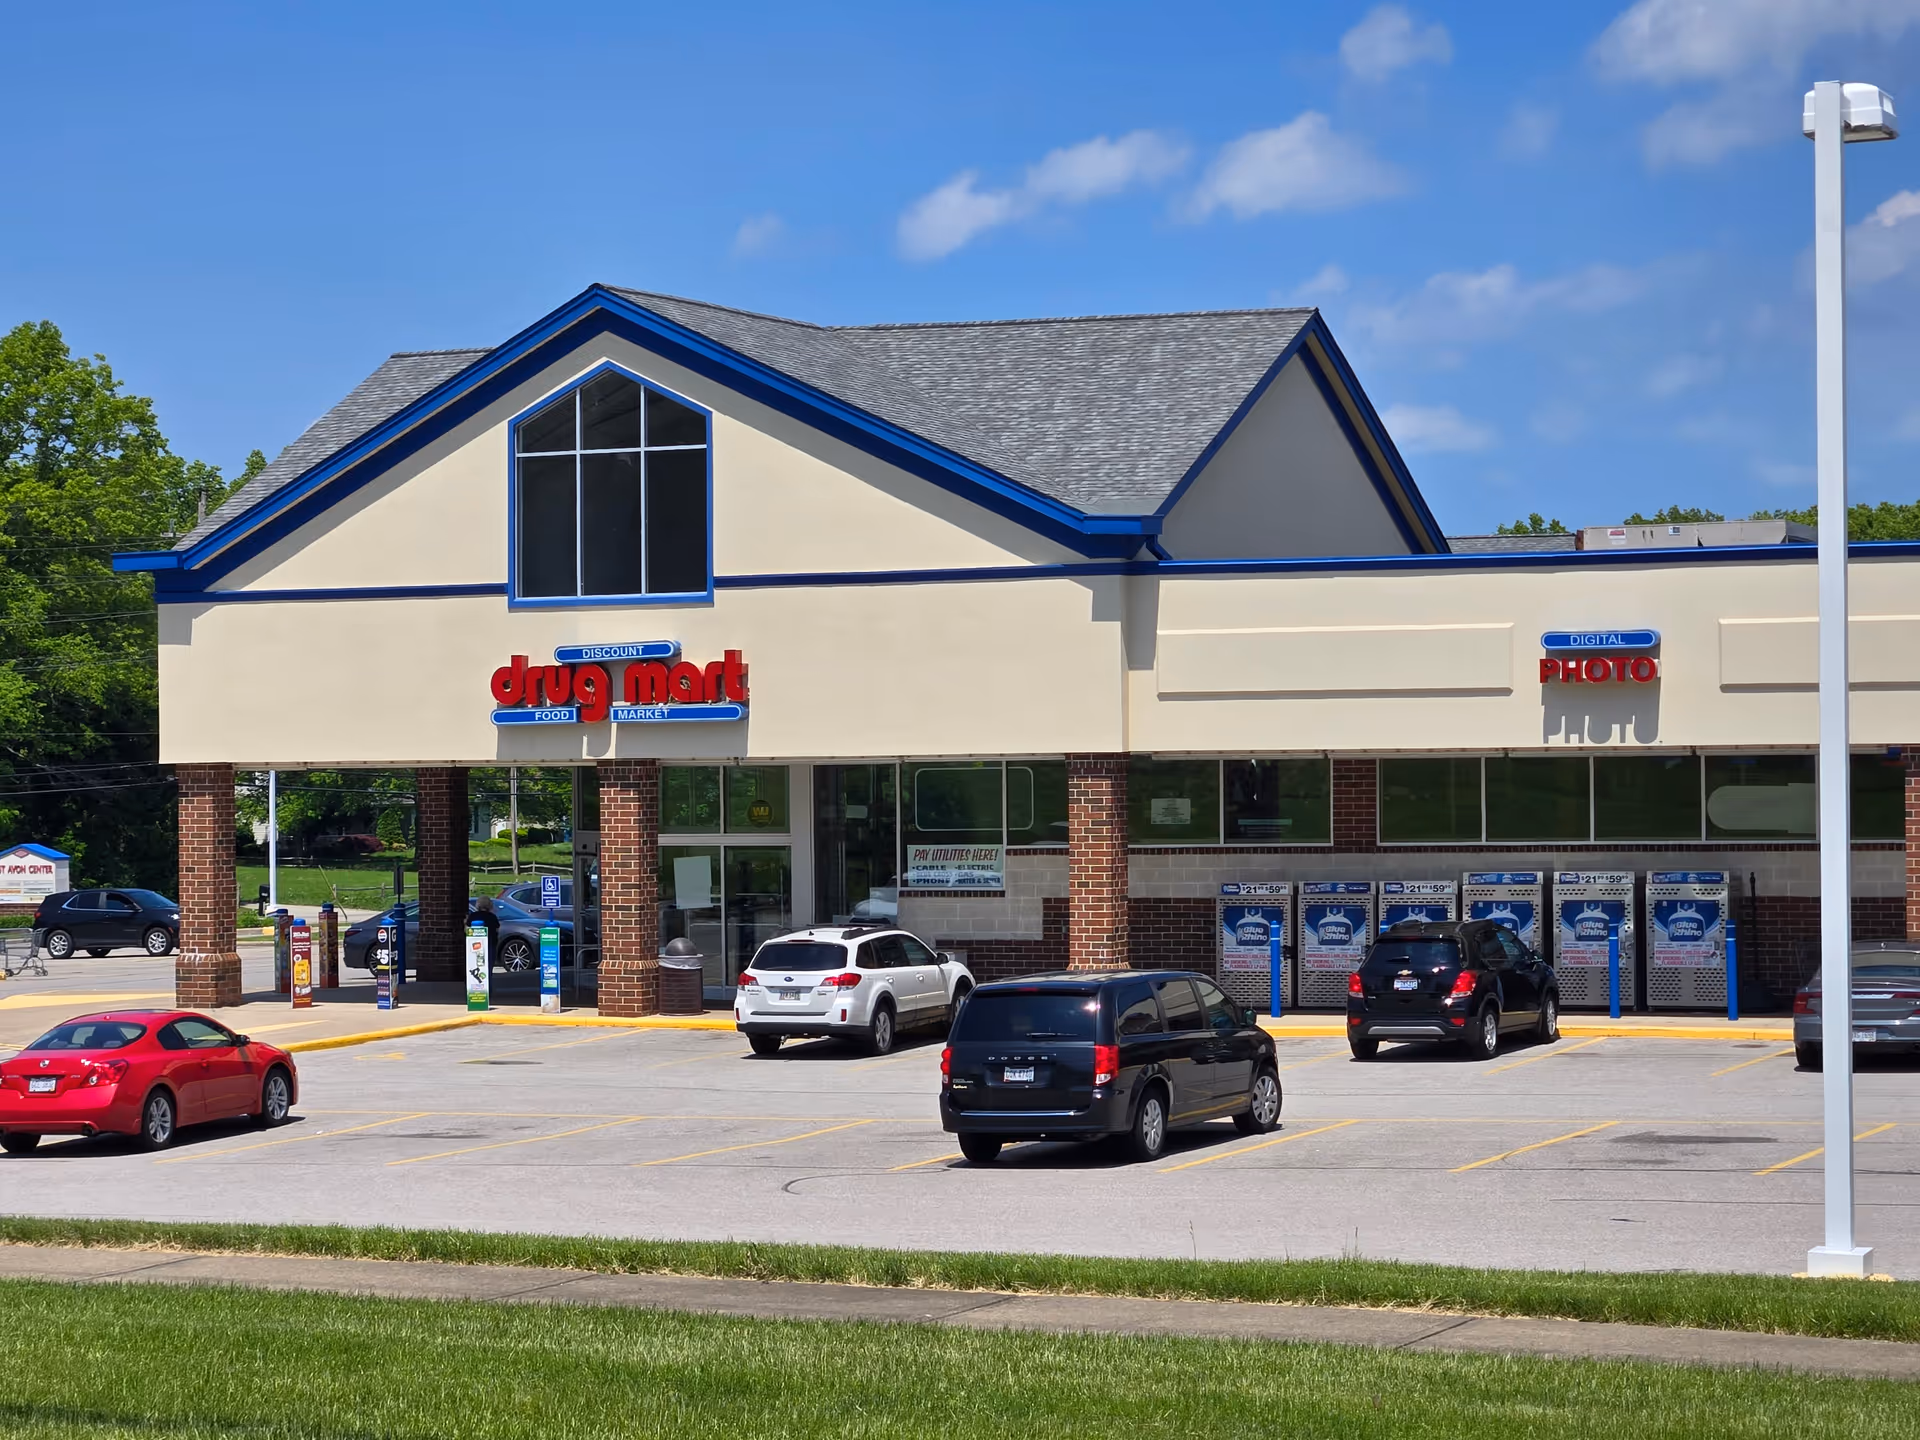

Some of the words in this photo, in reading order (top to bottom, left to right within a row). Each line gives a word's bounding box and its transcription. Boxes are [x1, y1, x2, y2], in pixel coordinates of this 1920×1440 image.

[1570, 634, 1626, 646] DIGITAL
[582, 646, 645, 659] DISCOUNT
[1538, 656, 1657, 684] PHOTO
[490, 655, 613, 723] drug
[624, 649, 749, 704] mart
[535, 711, 569, 721] FOOD
[617, 709, 670, 720] MARKET
[914, 848, 930, 861] PAY
[931, 848, 971, 861] UTILITIES
[971, 848, 999, 861] HERE!
[8, 865, 26, 874] AVON
[28, 865, 53, 874] CENTER
[376, 948, 389, 965] $5
